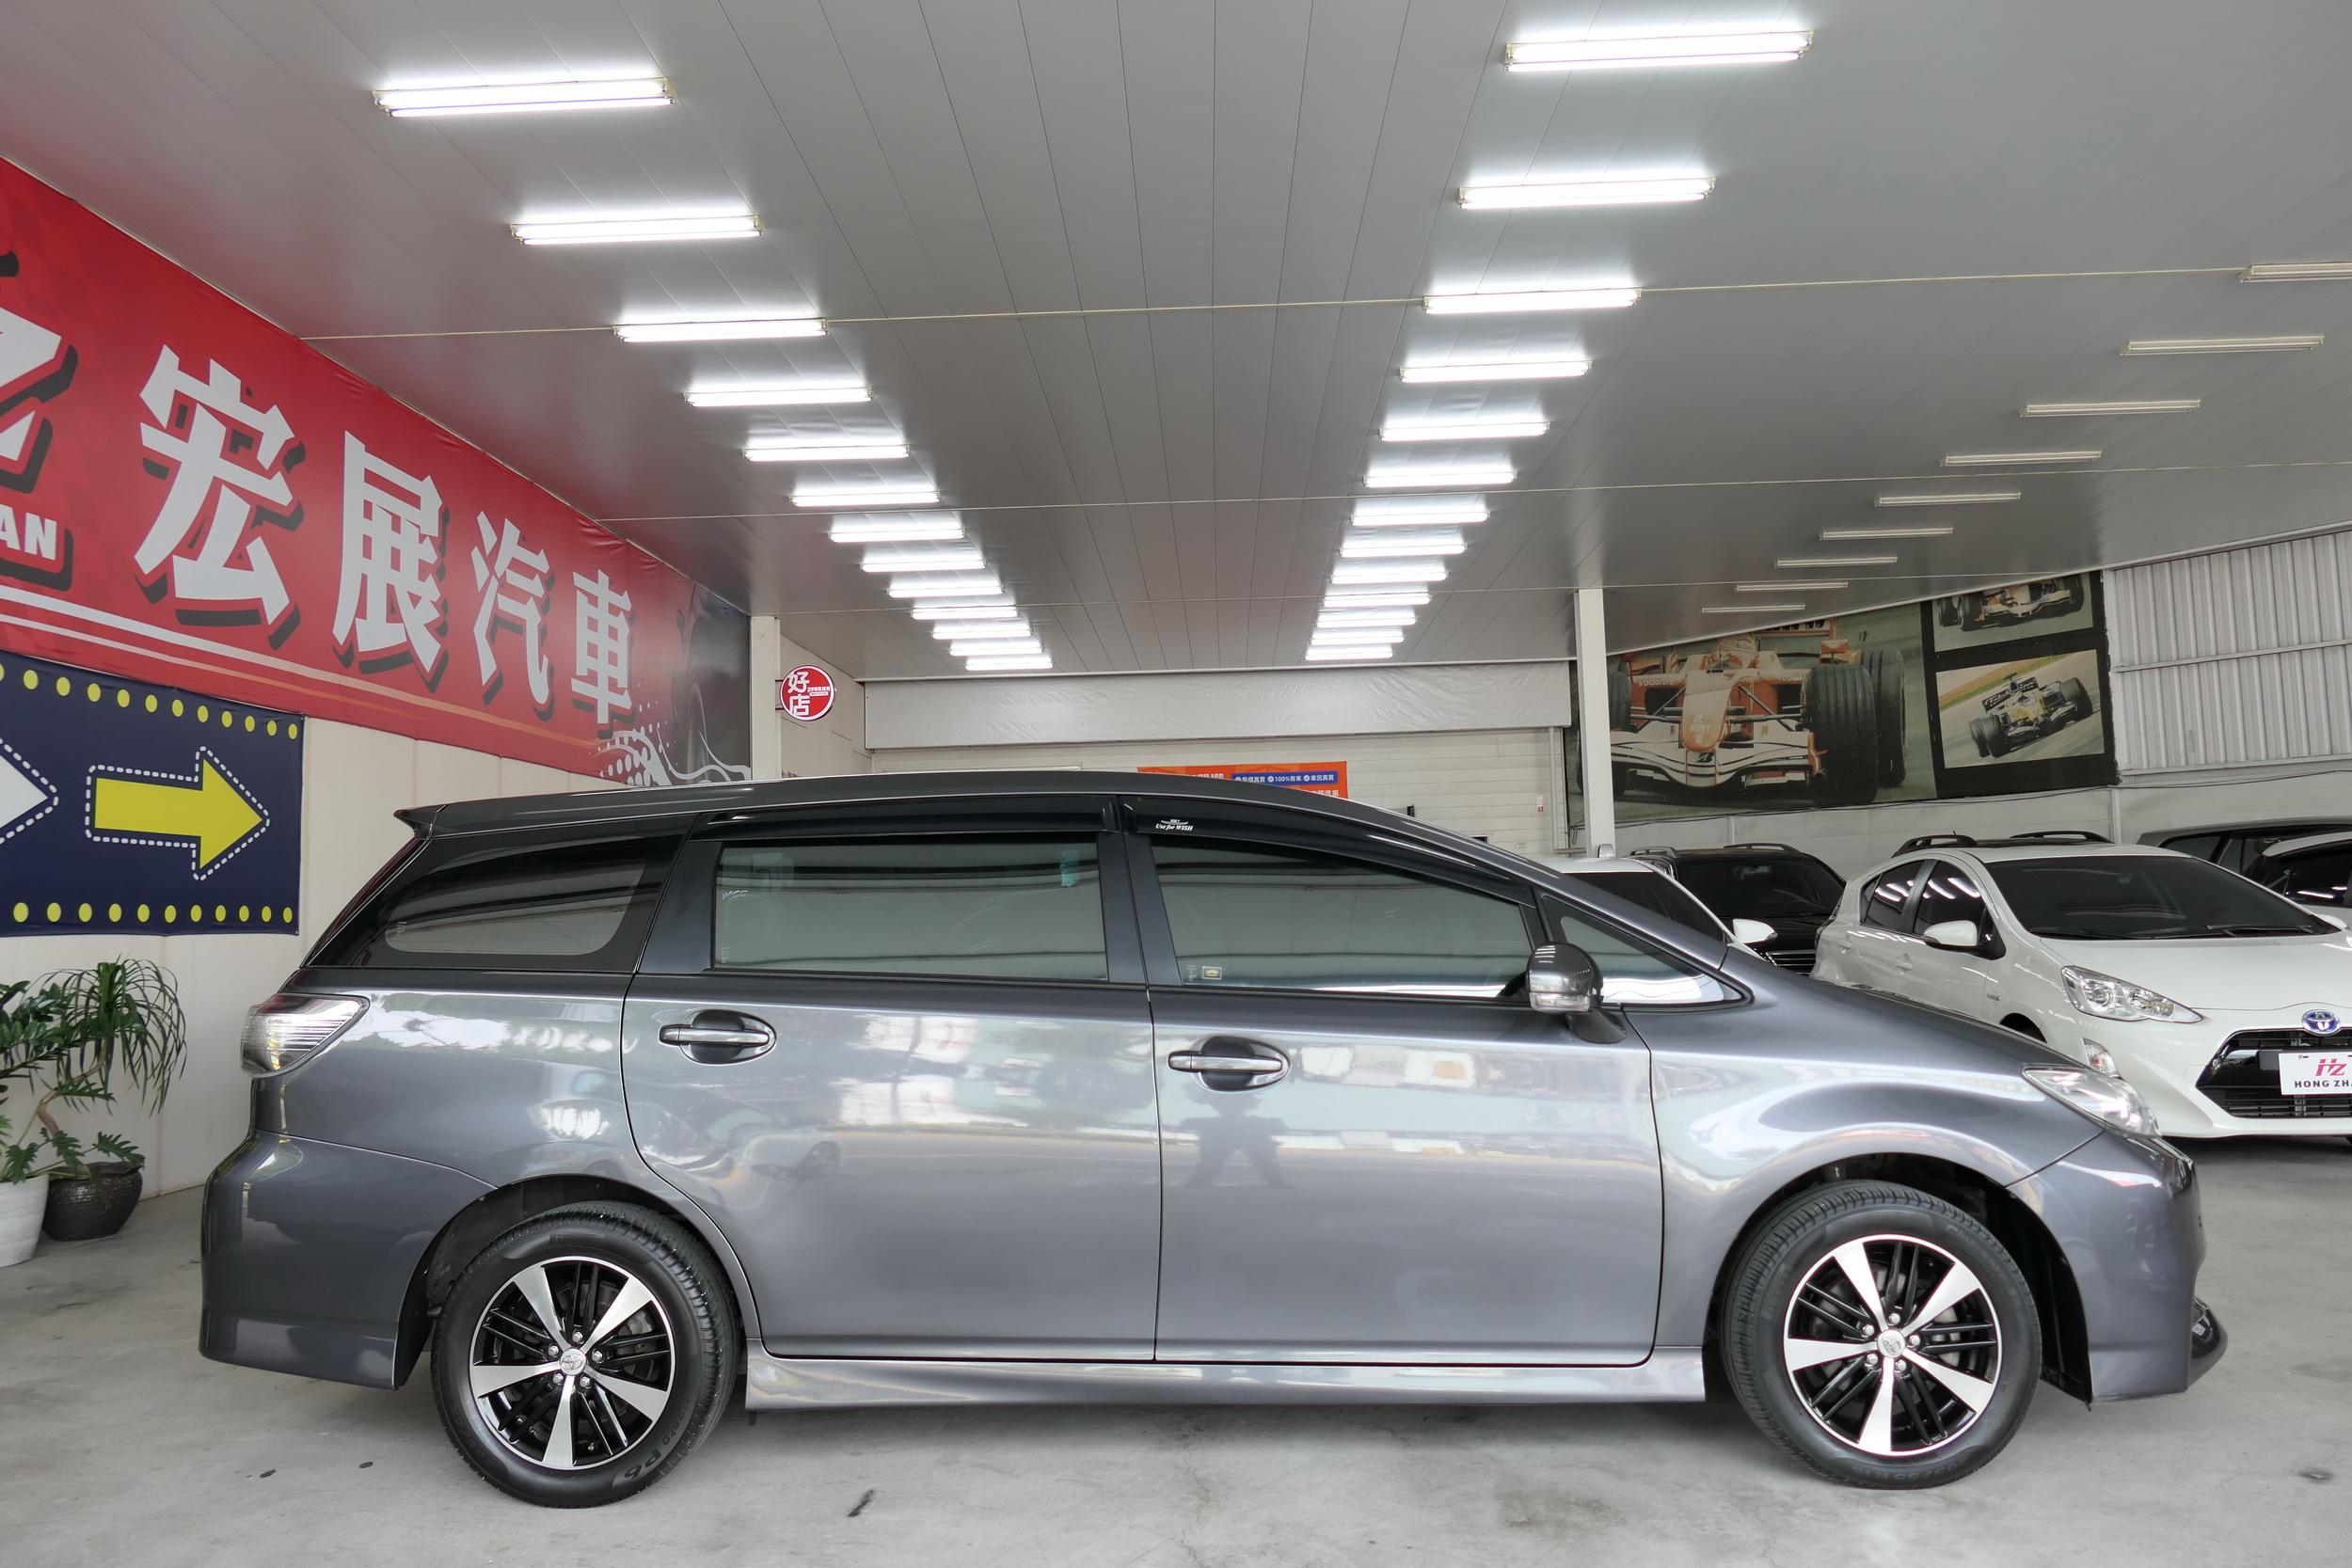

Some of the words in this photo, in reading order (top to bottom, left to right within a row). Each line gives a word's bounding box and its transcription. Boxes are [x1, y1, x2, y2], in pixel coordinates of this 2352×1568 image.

[135, 343, 634, 725] 宏展汽車
[787, 671, 810, 716] 好店
[2295, 1080, 2330, 1088] HONG
[2333, 1079, 2352, 1087] ZH
